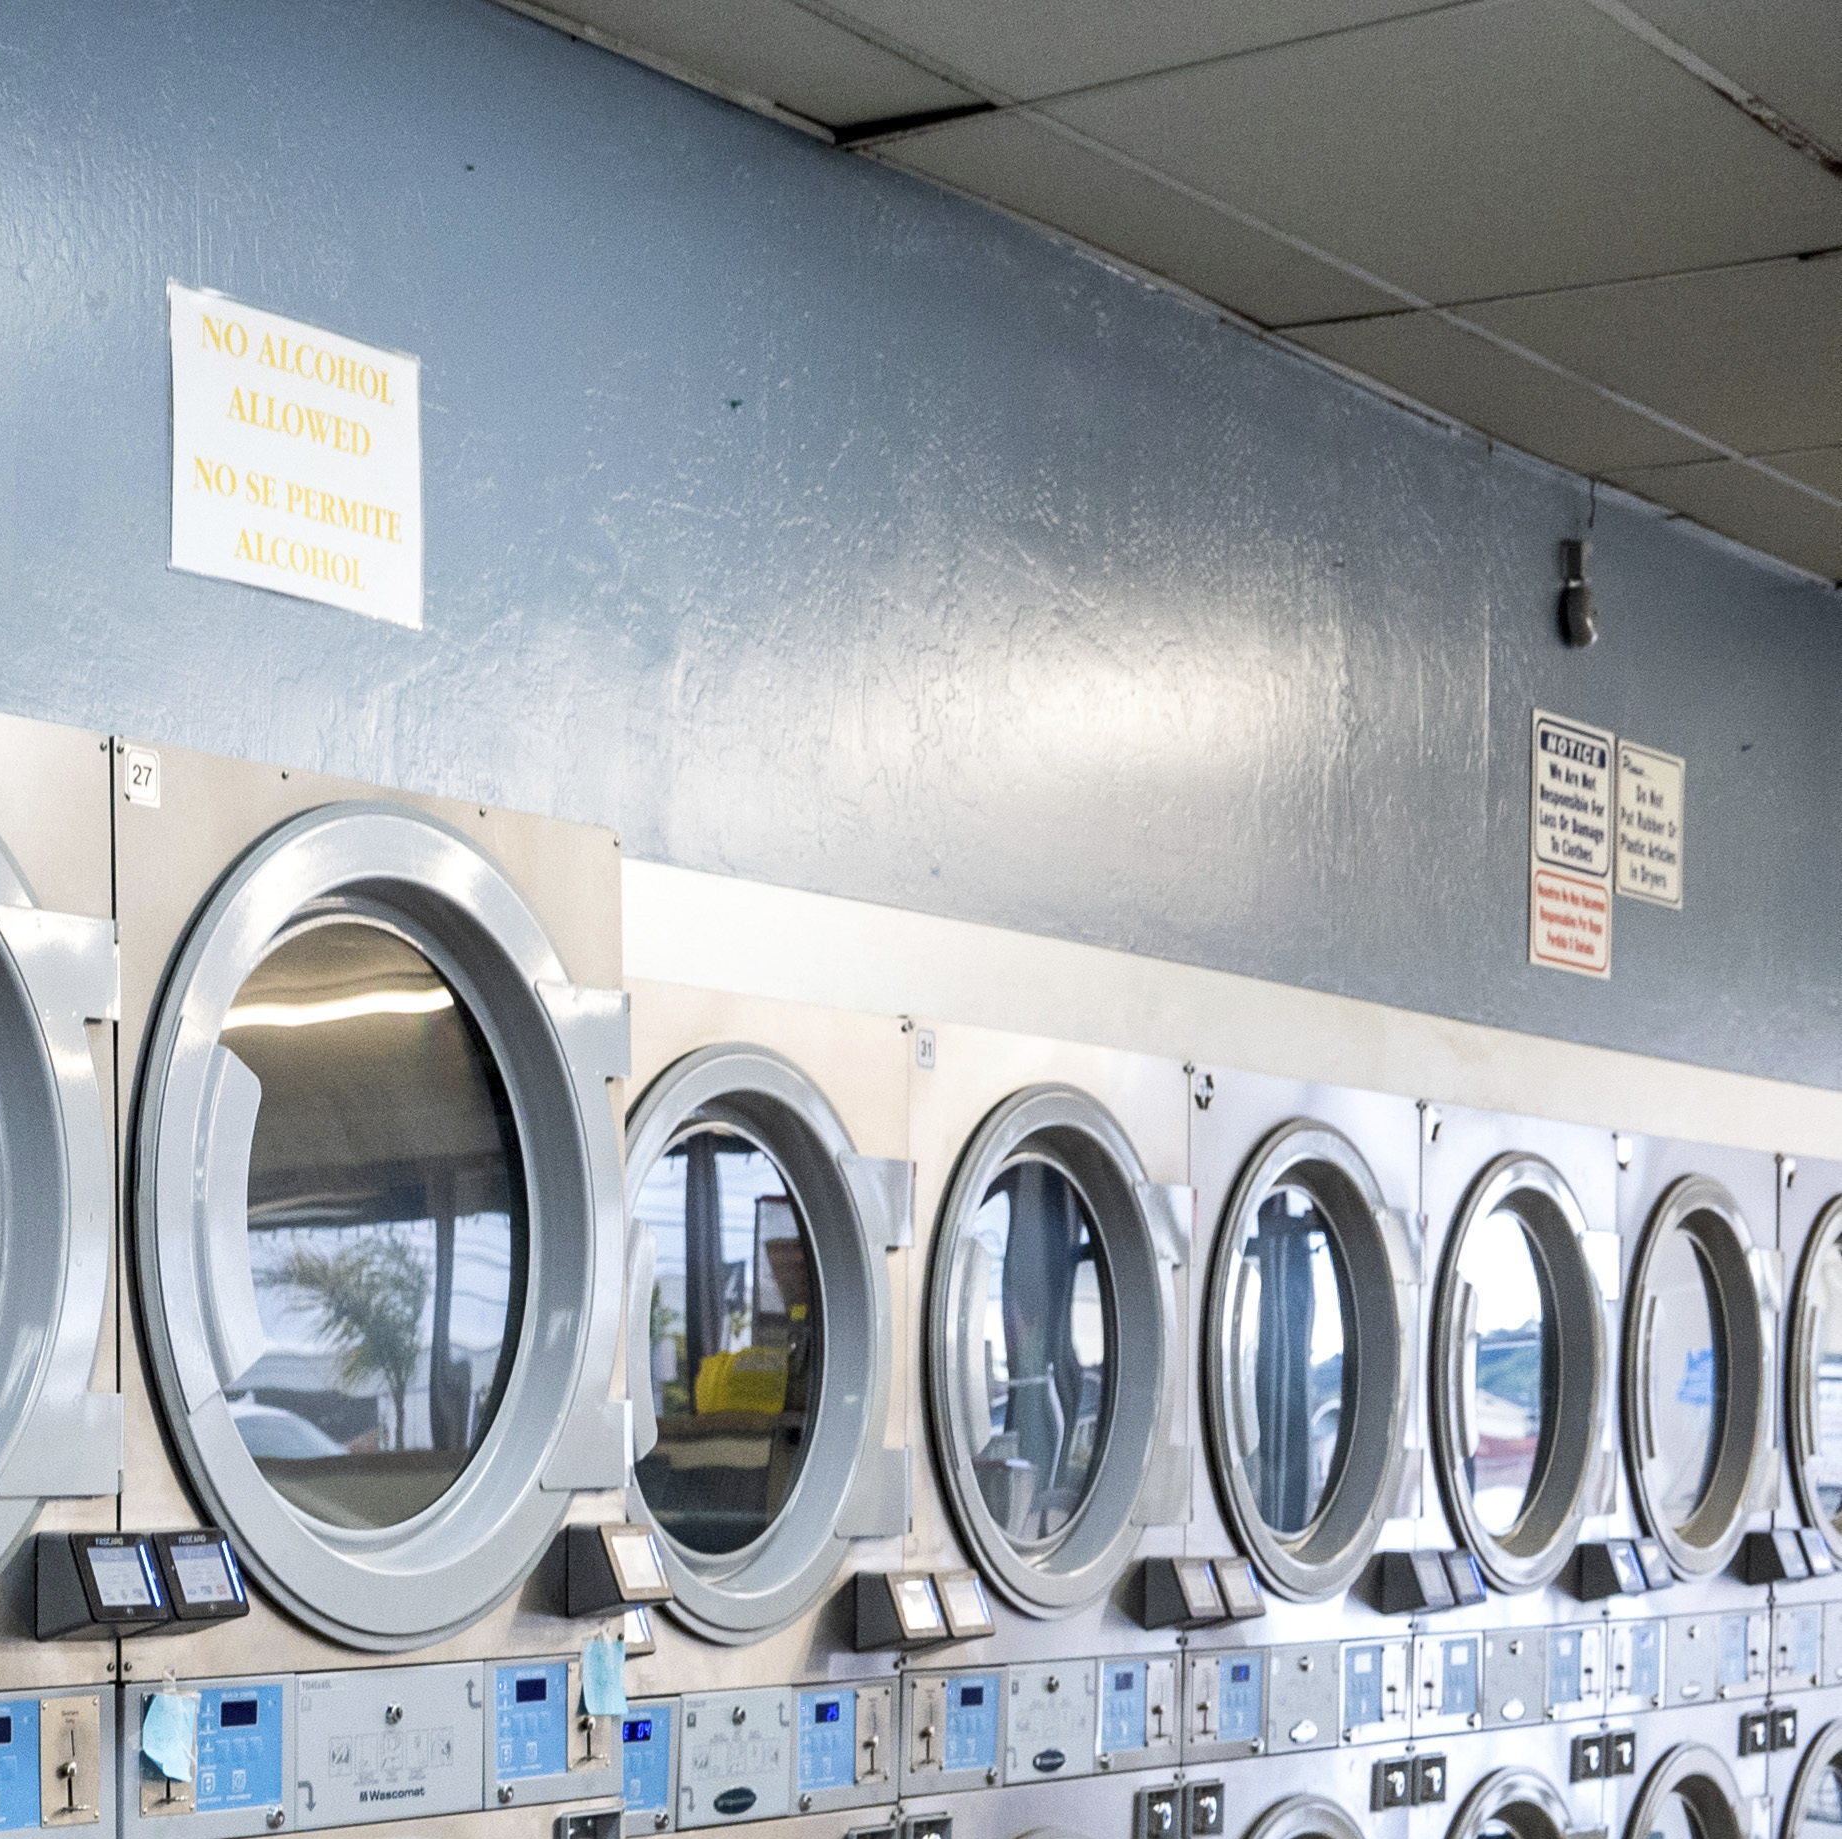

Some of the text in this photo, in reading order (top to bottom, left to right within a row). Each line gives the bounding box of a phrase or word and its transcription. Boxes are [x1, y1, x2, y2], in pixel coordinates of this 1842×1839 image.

[200, 313, 396, 407] NO ALCOHOL
[227, 385, 371, 457] ALLOWED
[193, 454, 403, 545] NO SE PERMITE
[234, 527, 366, 592] ALCOHOL
[132, 763, 153, 787] 27
[368, 1786, 426, 1802] Wascomat
